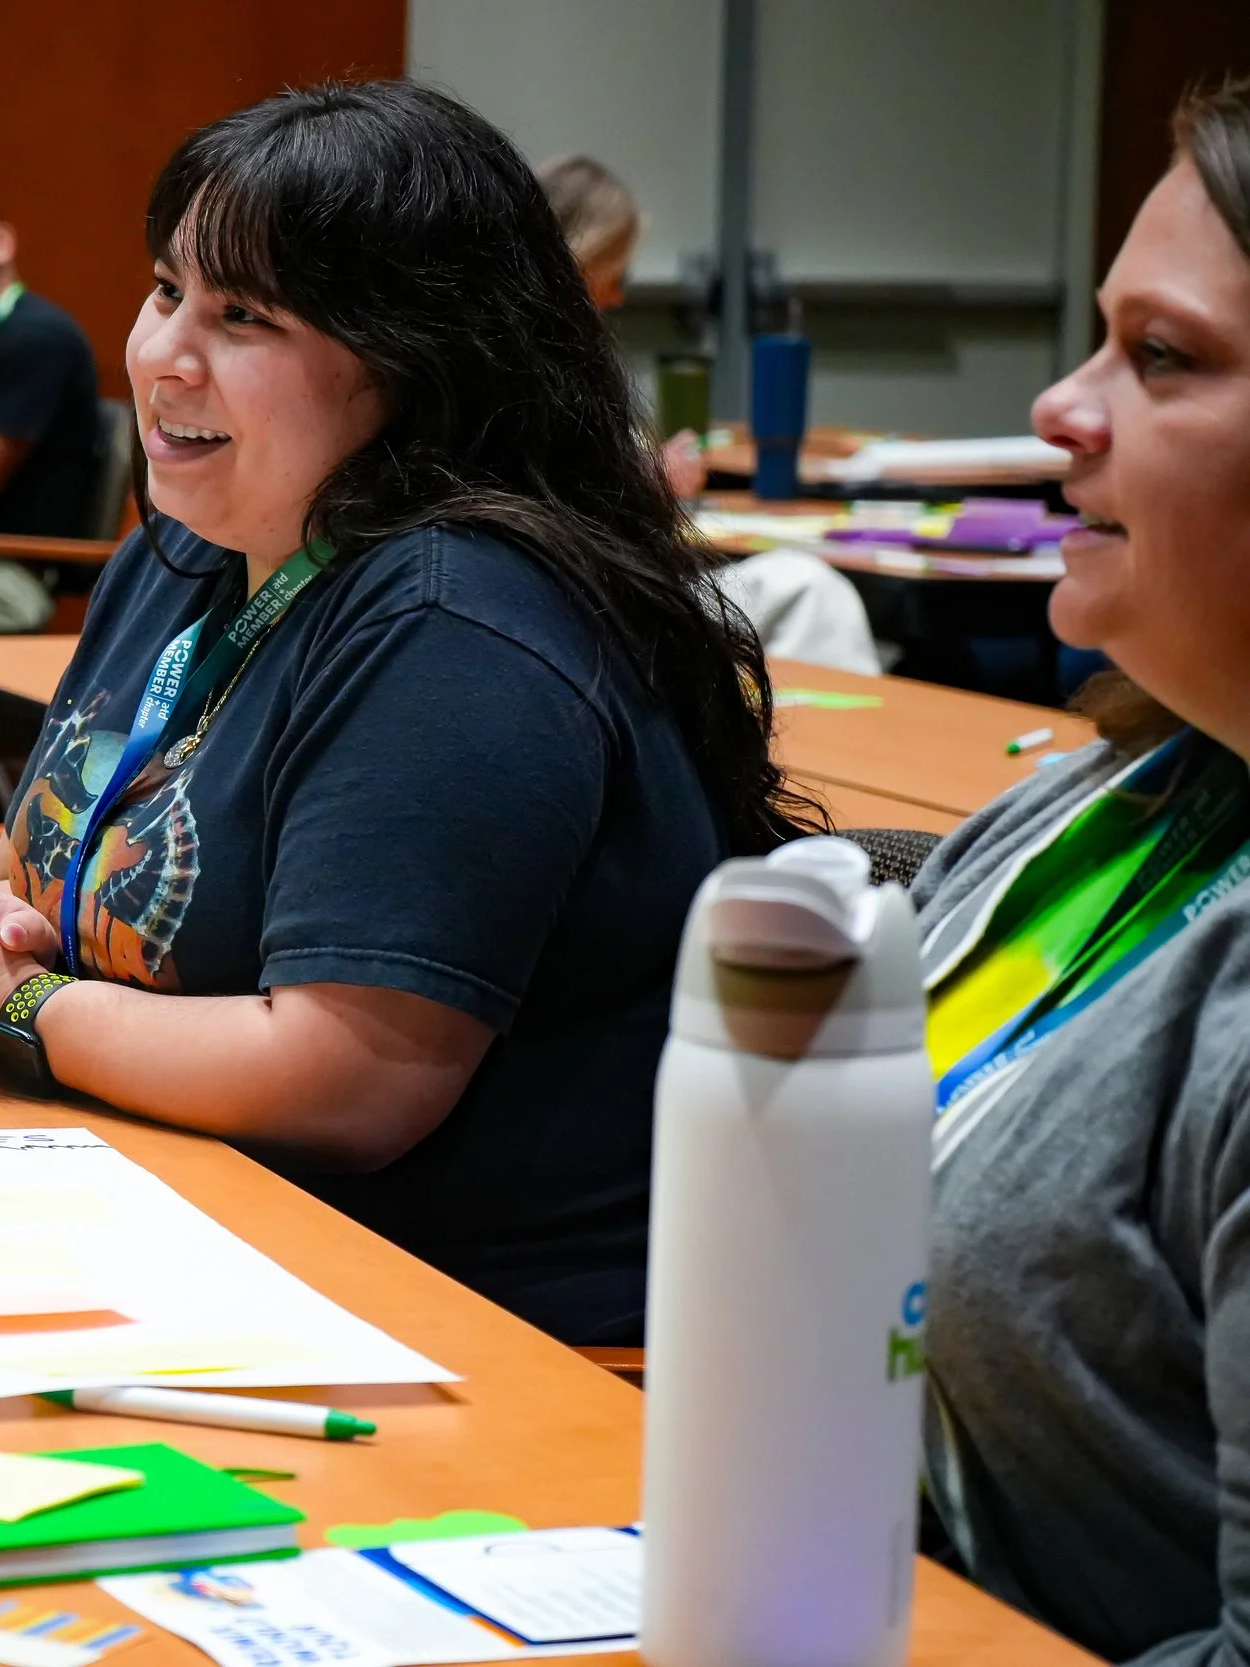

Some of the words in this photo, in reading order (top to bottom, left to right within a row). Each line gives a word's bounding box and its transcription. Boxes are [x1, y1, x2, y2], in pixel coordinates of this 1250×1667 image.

[228, 590, 273, 643] POWER
[272, 572, 289, 590] atd
[237, 599, 283, 649] MEMBER
[150, 639, 180, 694] MEMBER
[164, 640, 192, 699] POWER
[138, 697, 155, 729] chapter
[158, 702, 170, 721] atd
